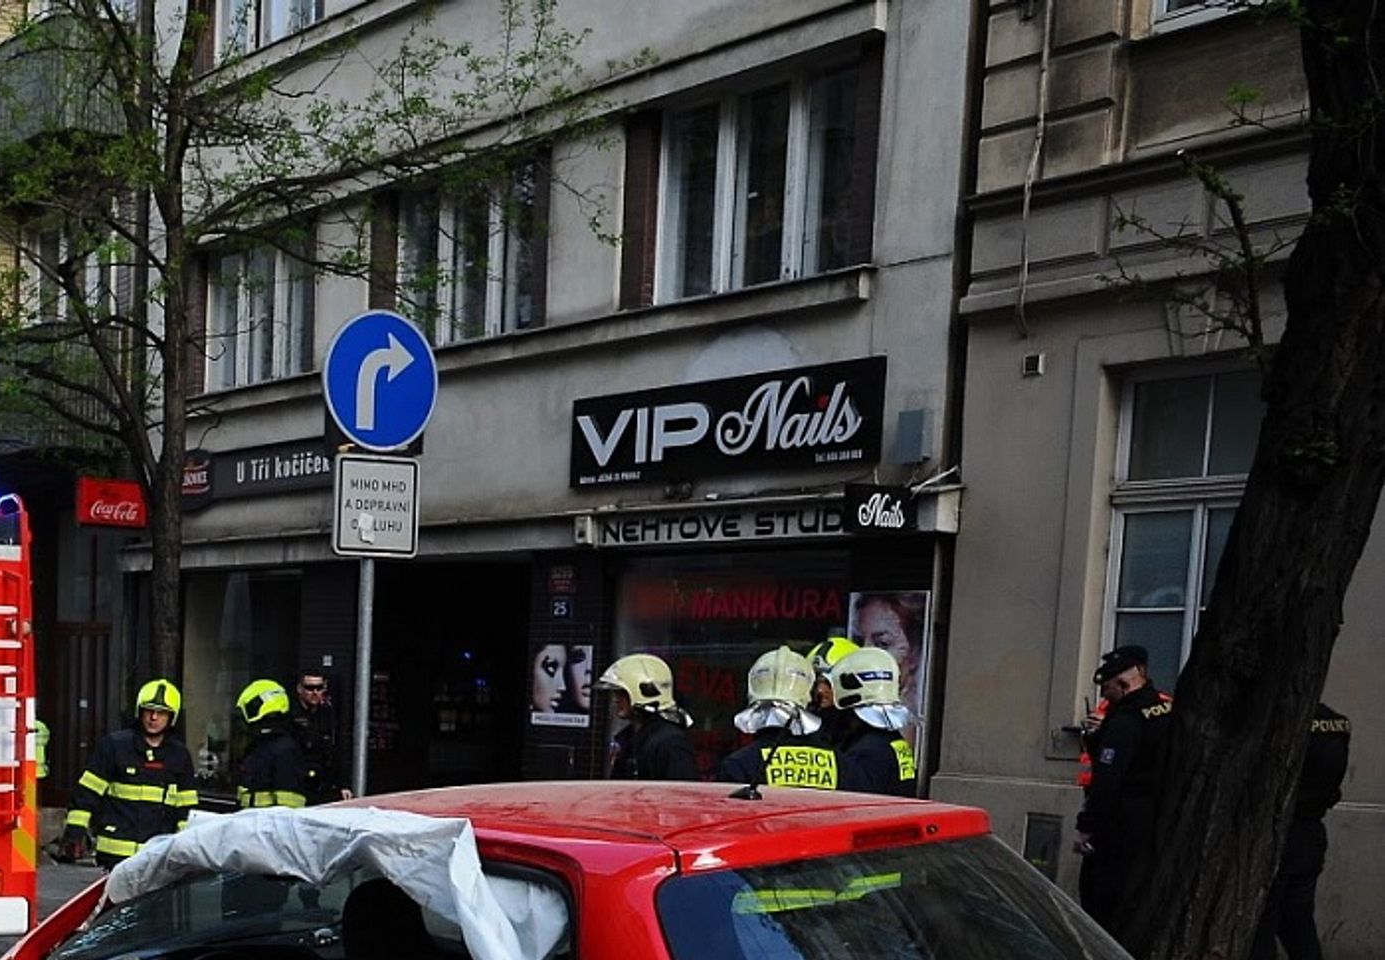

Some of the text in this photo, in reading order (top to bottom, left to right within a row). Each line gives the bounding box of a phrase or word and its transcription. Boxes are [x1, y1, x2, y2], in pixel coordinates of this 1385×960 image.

[576, 376, 863, 467] VIP Nails
[236, 461, 245, 483] U
[350, 479, 407, 493] MIMO MHD
[344, 499, 353, 510] A
[858, 493, 905, 528] Nails
[350, 518, 403, 533] OLUHU
[755, 507, 843, 536] STUD
[553, 601, 568, 616] 25
[770, 768, 833, 786] PRAHA
